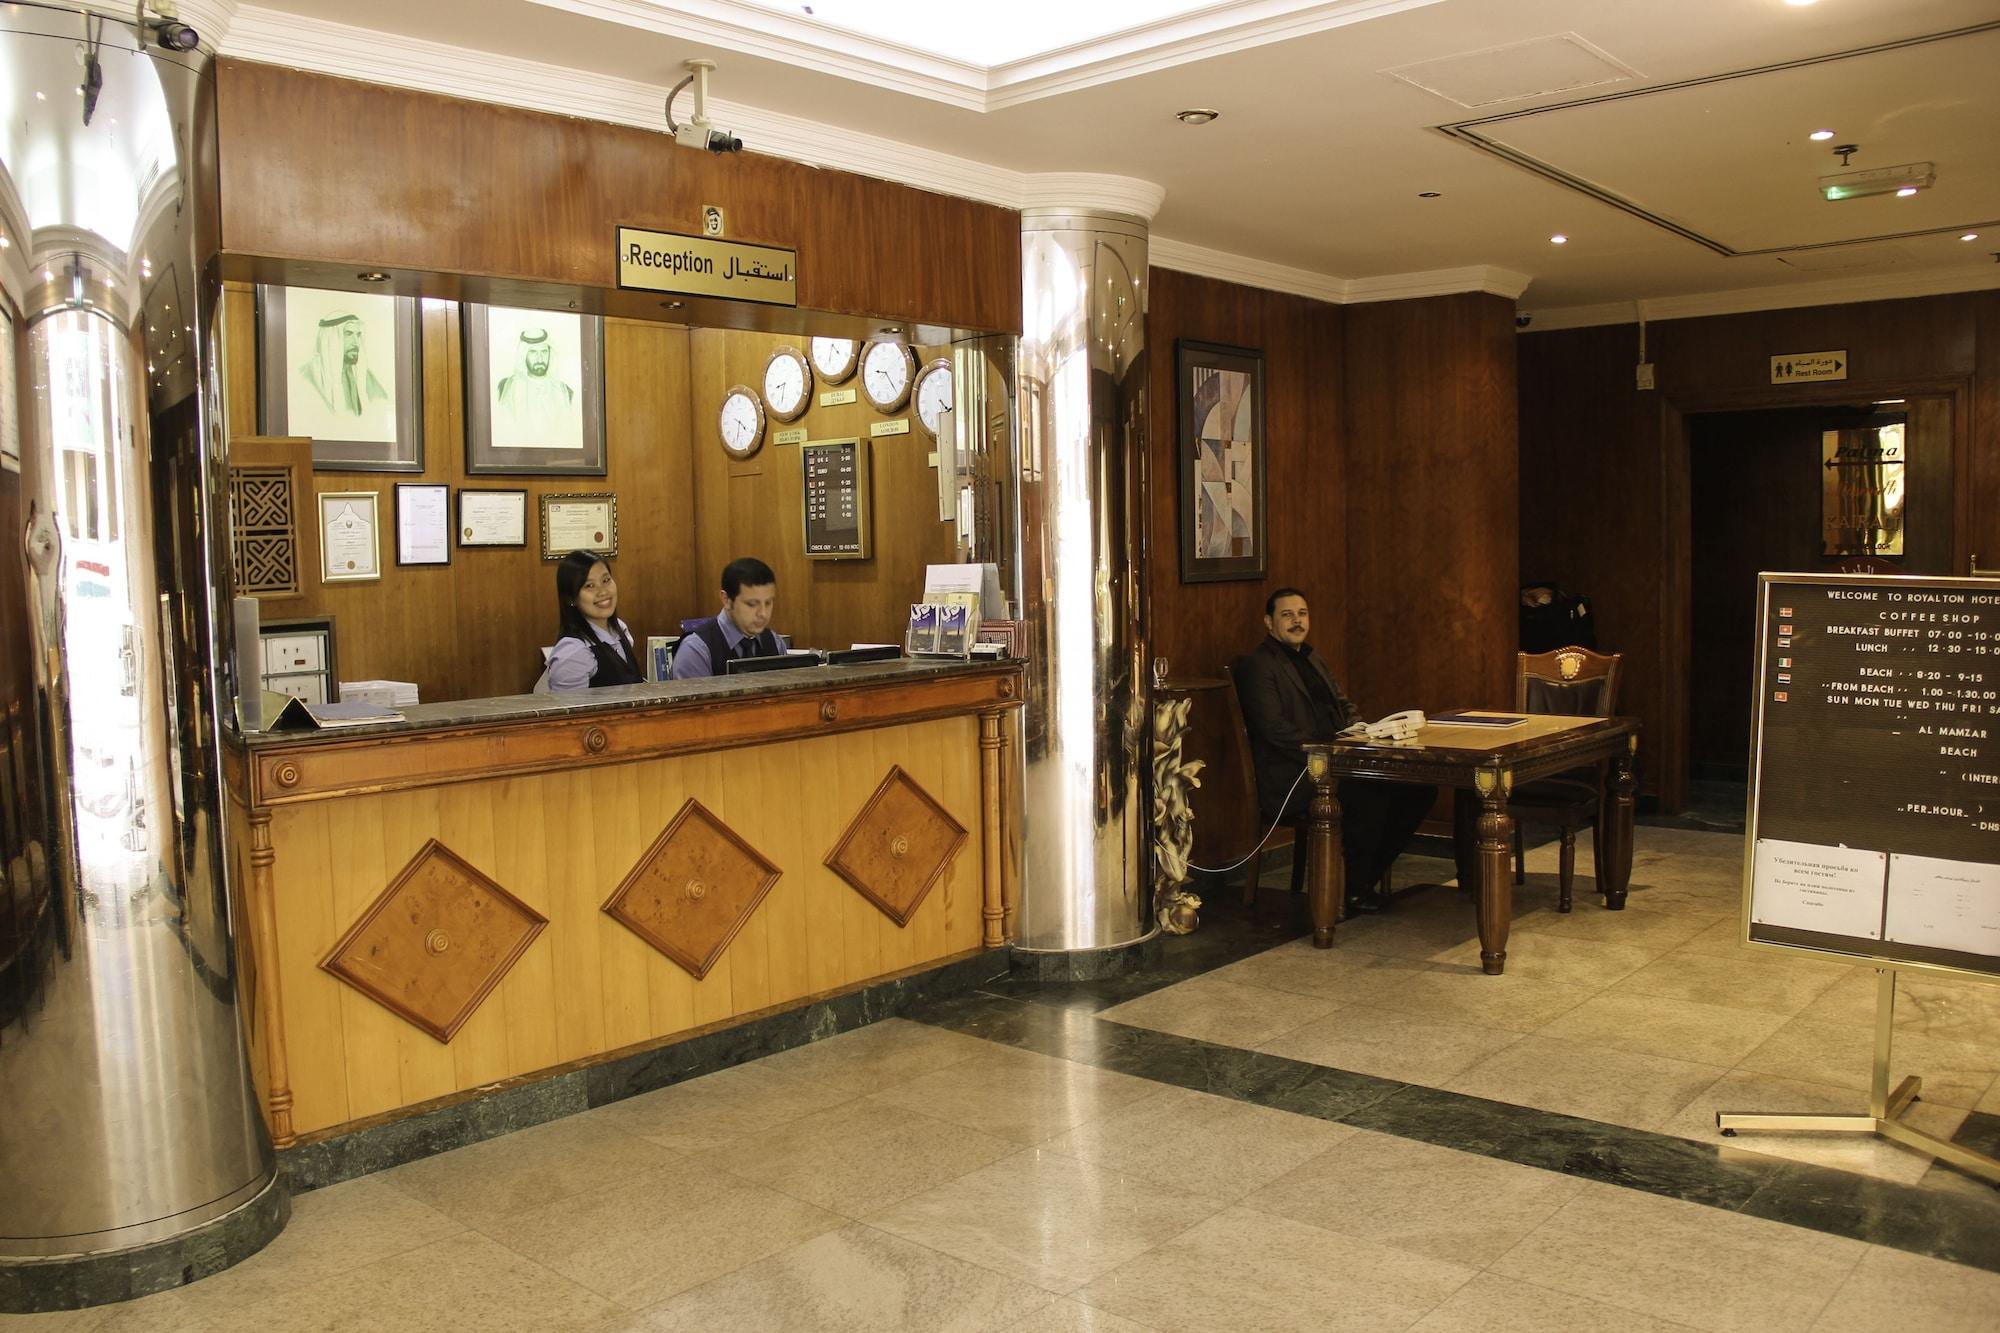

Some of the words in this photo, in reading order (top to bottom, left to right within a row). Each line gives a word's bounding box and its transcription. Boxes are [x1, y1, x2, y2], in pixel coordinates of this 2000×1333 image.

[630, 243, 713, 275] Reception
[723, 256, 788, 282] استقبال
[1827, 590, 1878, 600] WELCOME
[1888, 592, 1902, 602] TO
[1907, 594, 1965, 603] ROYALTON
[1971, 596, 2000, 605] HOTE
[1880, 612, 1936, 622] COFFEE
[1942, 614, 1980, 624] SHOP
[1826, 626, 1879, 636] BREAKFAST
[1884, 628, 1920, 638] BUFFET
[1856, 643, 1888, 652] LUNCH
[1859, 668, 1893, 677] BEACH
[1861, 684, 1894, 694] BEACH
[1827, 696, 1849, 704] SUN
[1855, 697, 1879, 706] MON
[1884, 699, 1902, 708] TUE
[1907, 701, 1930, 710] WED
[1935, 702, 1955, 712] THU
[1962, 705, 1981, 713] FRI
[1918, 726, 1933, 734] AL
[1939, 727, 1987, 738] MAMZAR
[1940, 746, 1977, 757] BEACH
[1980, 822, 2000, 831] DHS
